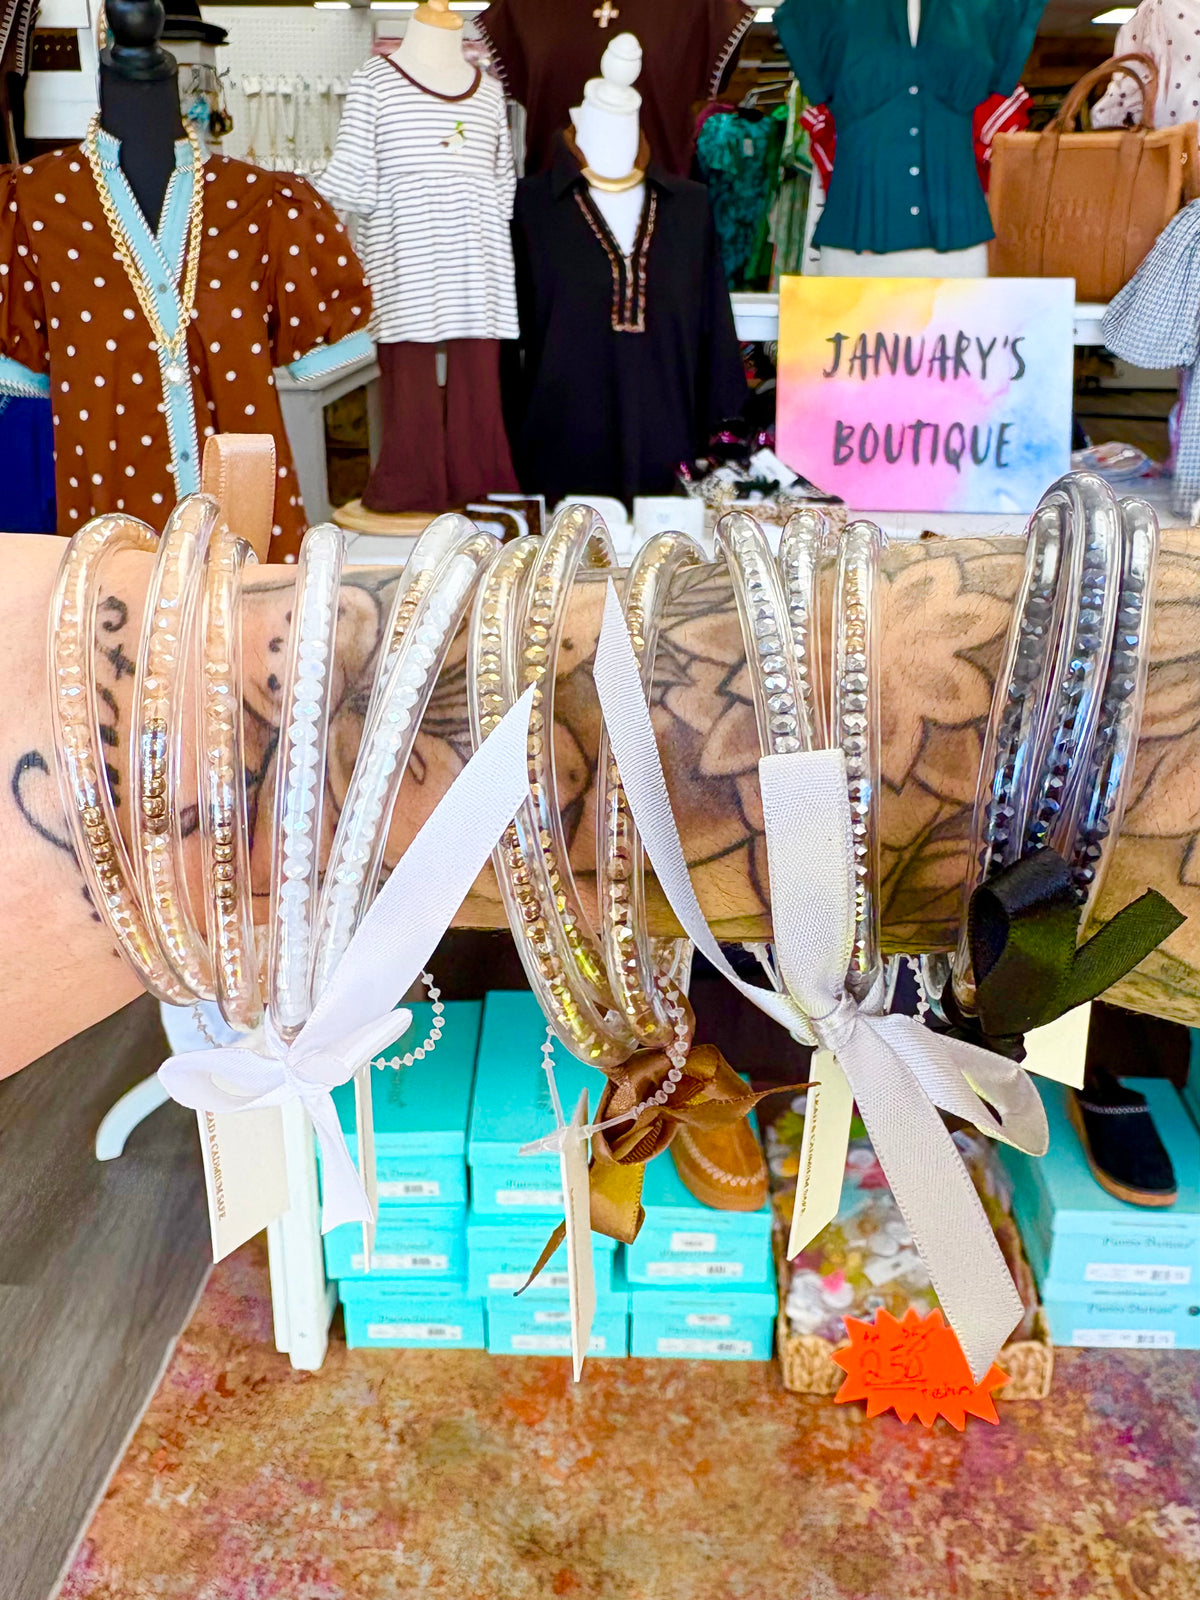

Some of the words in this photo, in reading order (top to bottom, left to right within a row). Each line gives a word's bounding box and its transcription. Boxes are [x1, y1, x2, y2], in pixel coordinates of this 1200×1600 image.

[822, 330, 1026, 382] JANUARY'S
[833, 418, 1014, 473] BOUTIQUE
[205, 1110, 216, 1133] EAD
